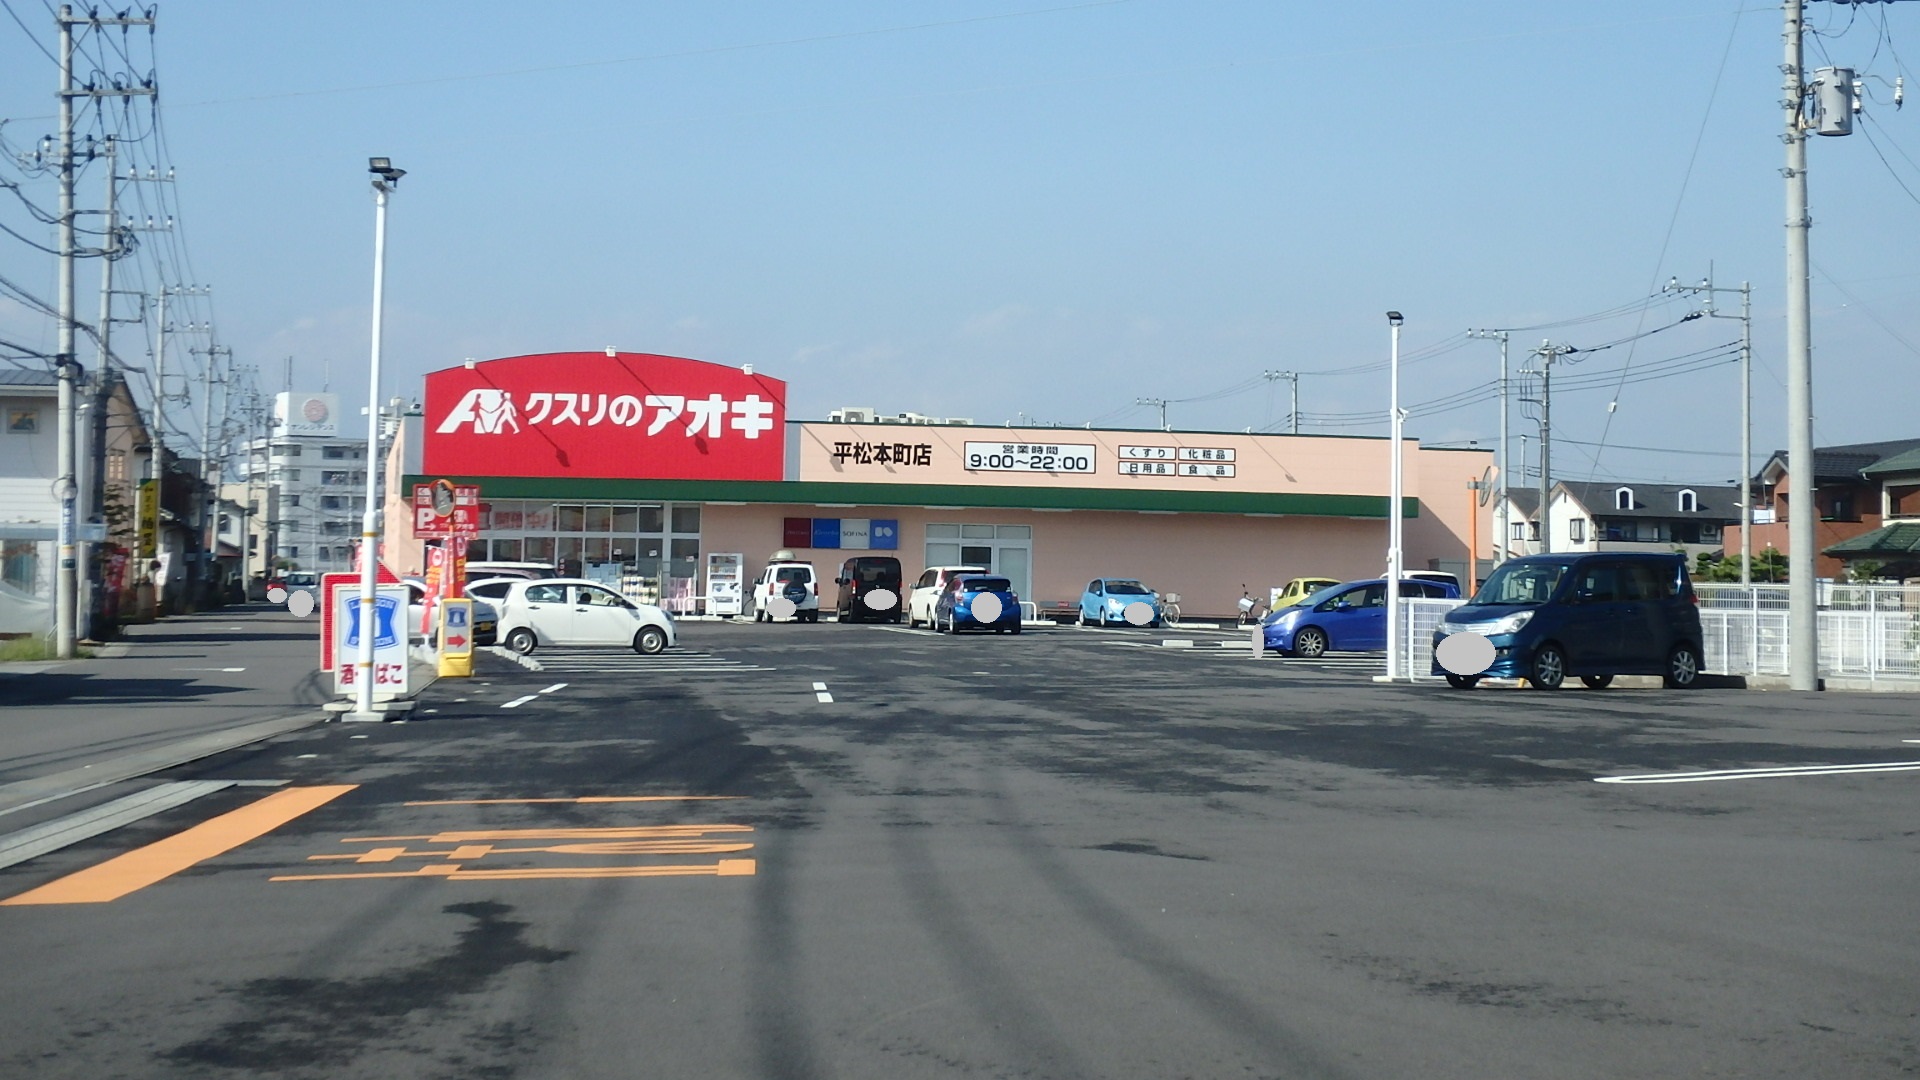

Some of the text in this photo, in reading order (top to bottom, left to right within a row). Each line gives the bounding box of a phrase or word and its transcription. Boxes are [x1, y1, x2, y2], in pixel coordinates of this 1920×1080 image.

[525, 393, 773, 439] クスリのアオキ
[833, 442, 932, 466] 平松本町店
[1002, 444, 1059, 455] 営業時間
[1129, 448, 1166, 458] くすり
[1188, 449, 1225, 460] 化粧品
[1129, 463, 1166, 474] 日用品
[417, 508, 435, 530] P
[341, 664, 402, 685] 酒・ばこ
